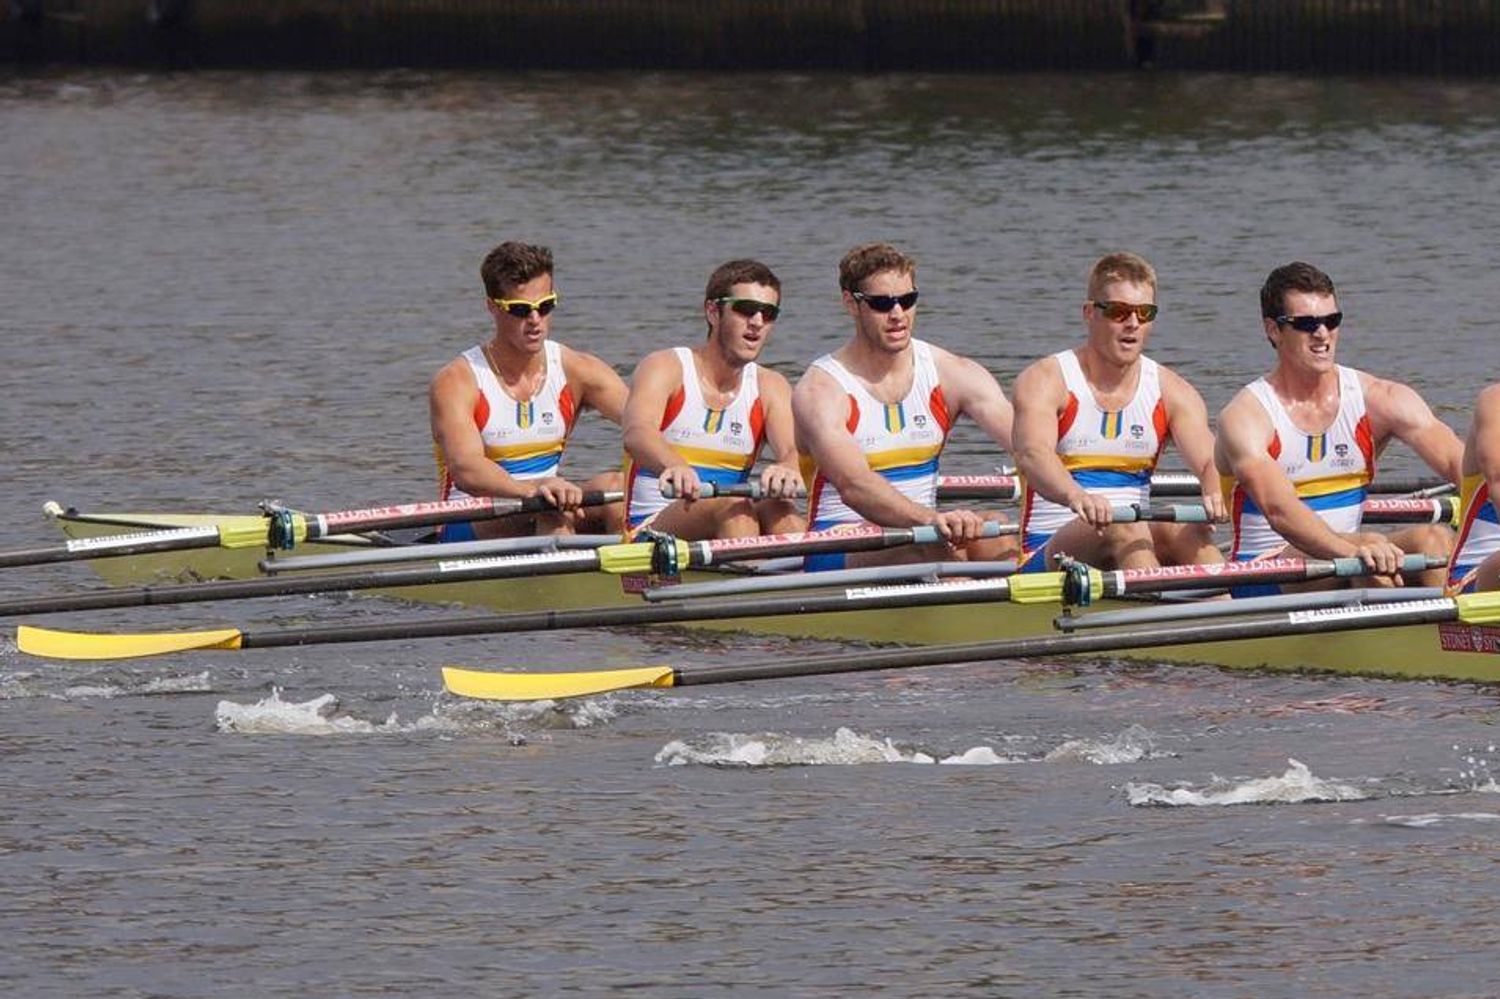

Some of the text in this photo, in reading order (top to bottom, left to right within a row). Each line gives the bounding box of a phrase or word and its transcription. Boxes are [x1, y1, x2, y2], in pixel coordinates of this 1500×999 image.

[1370, 499, 1427, 510] SYDNEY
[1127, 557, 1298, 578] SYDNEY SYDNEY
